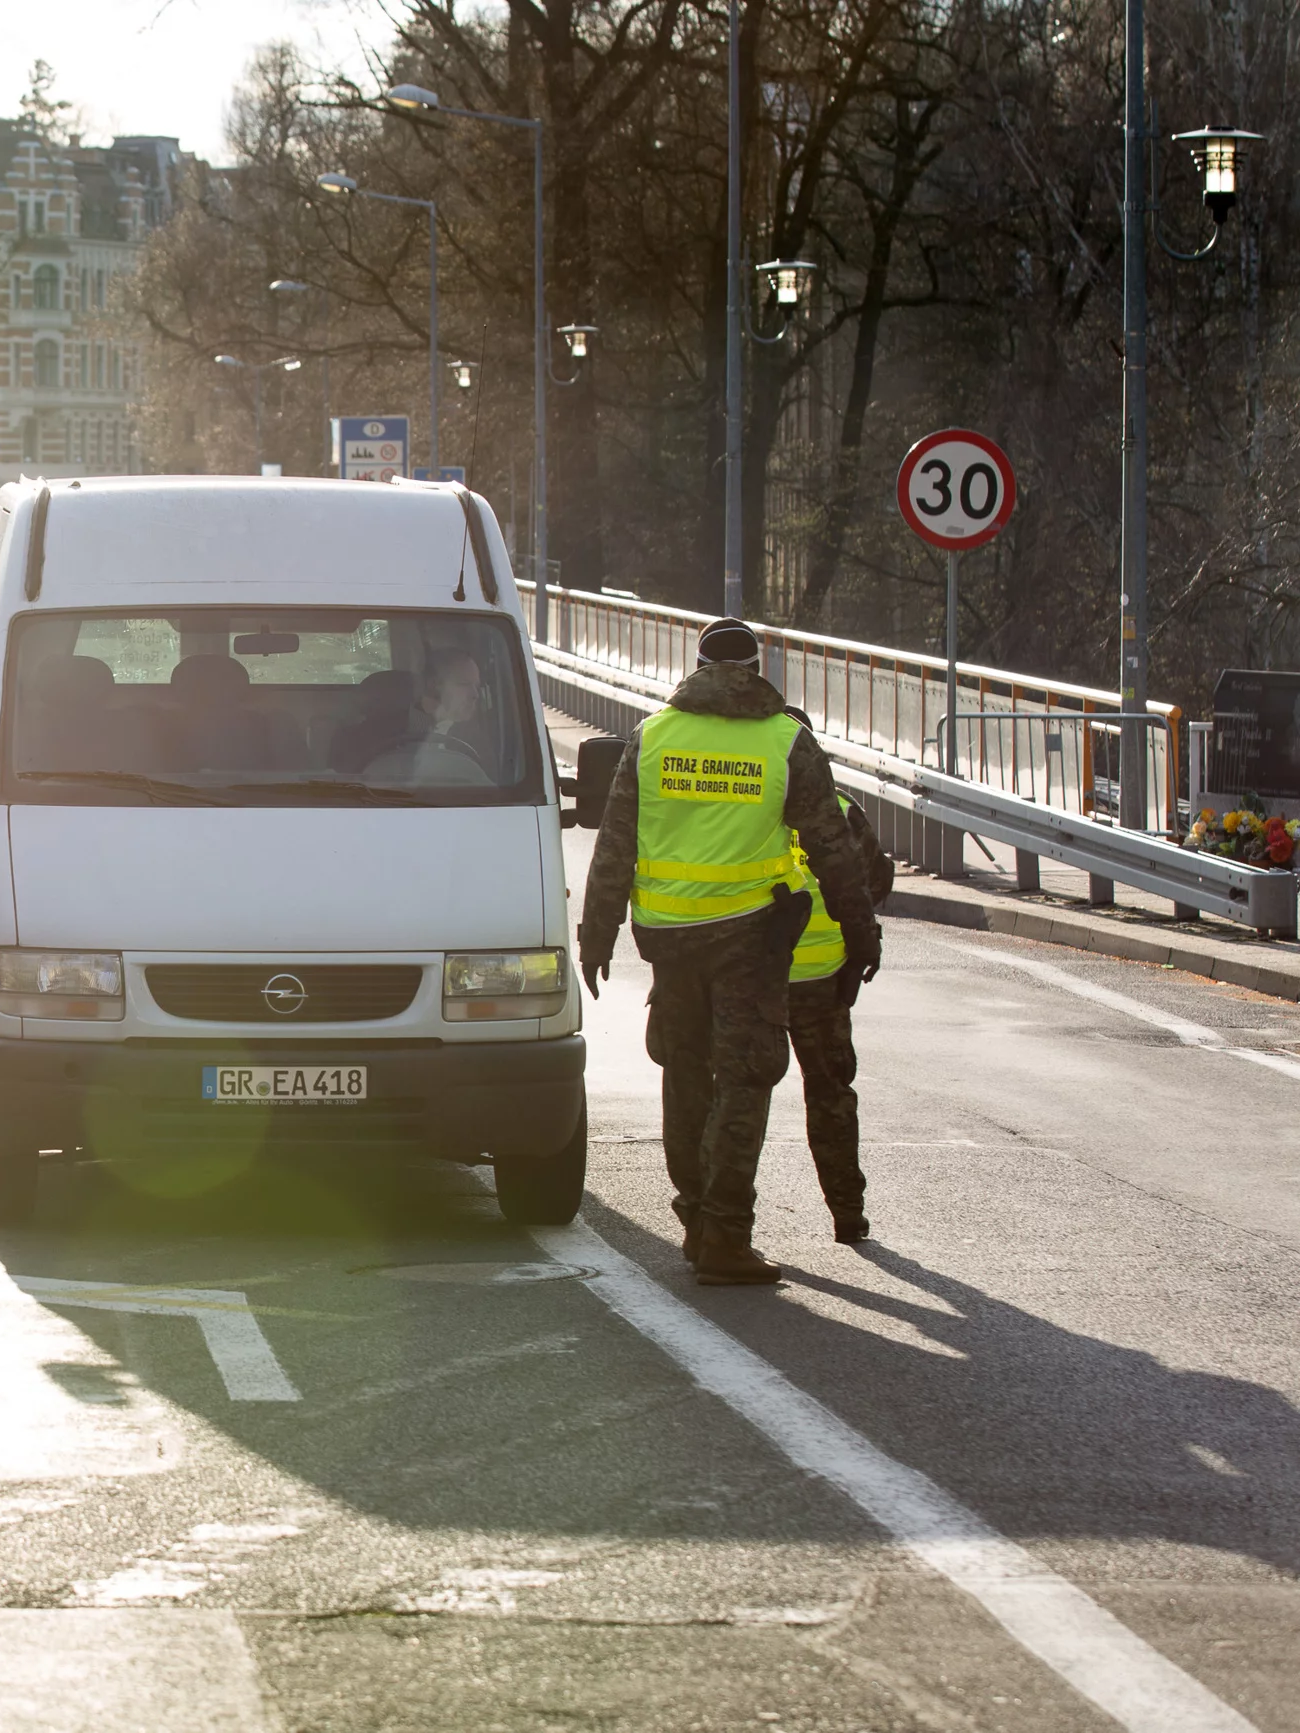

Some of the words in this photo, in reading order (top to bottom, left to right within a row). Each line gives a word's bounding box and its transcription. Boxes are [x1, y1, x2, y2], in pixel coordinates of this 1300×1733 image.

[916, 459, 998, 520] 30
[662, 756, 698, 773] STRAŻ
[702, 759, 763, 778] GRANICZNA
[661, 778, 692, 791] POLISH
[695, 780, 729, 794] BORDER
[732, 782, 761, 796] GUARD
[219, 1070, 254, 1096] GR
[273, 1070, 308, 1096] EA
[313, 1070, 363, 1096] 418
